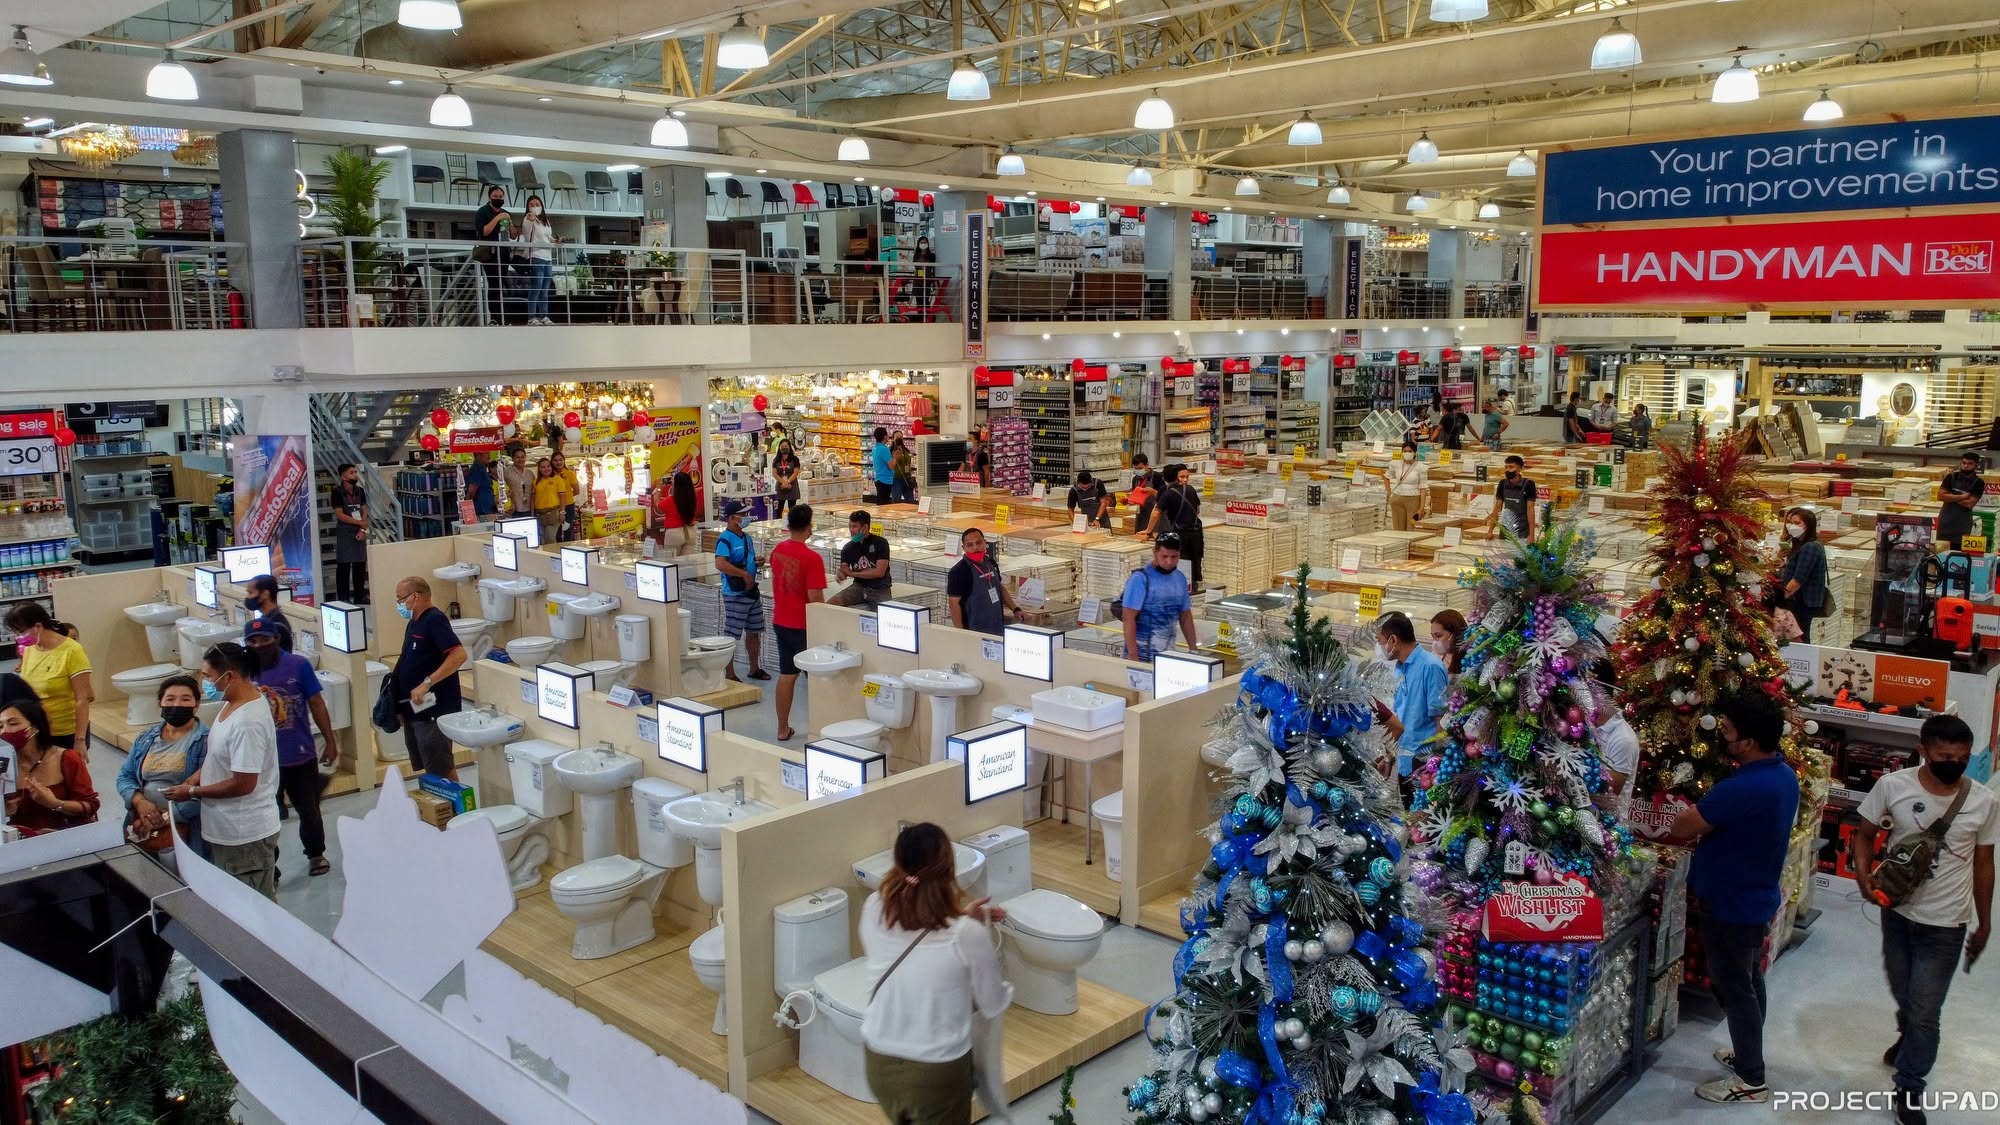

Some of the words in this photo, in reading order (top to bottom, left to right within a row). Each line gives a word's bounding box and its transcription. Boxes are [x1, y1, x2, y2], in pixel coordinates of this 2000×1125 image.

[1650, 147, 1733, 176] Your
[1746, 136, 1898, 175] partner
[1913, 129, 1946, 157] in
[1597, 186, 1692, 211] home
[1705, 163, 1999, 207] improvements
[896, 207, 915, 217] 450
[1597, 242, 1913, 284] HANDYMAN
[1927, 249, 1988, 272] Best
[971, 230, 979, 330] ELECTRICAL
[1349, 250, 1358, 319] ELECTRICA
[995, 391, 1008, 401] 80
[1087, 386, 1103, 395] 140
[18, 418, 48, 430] sale
[657, 438, 678, 447] TECH
[1232, 502, 1266, 511] MARIWASA
[1976, 623, 1997, 631] Series
[1881, 673, 1932, 686] multiEVO
[544, 683, 568, 699] American
[665, 720, 695, 739] American
[664, 732, 693, 751] Standard
[978, 749, 1017, 767] American
[816, 769, 854, 789] American
[977, 760, 1014, 781] Standard
[1635, 799, 1685, 813] CHRITMAS
[1630, 810, 1675, 828] ISHLIS
[1519, 882, 1582, 899] CHRISTMAS
[1493, 893, 1586, 917] WISHLIST
